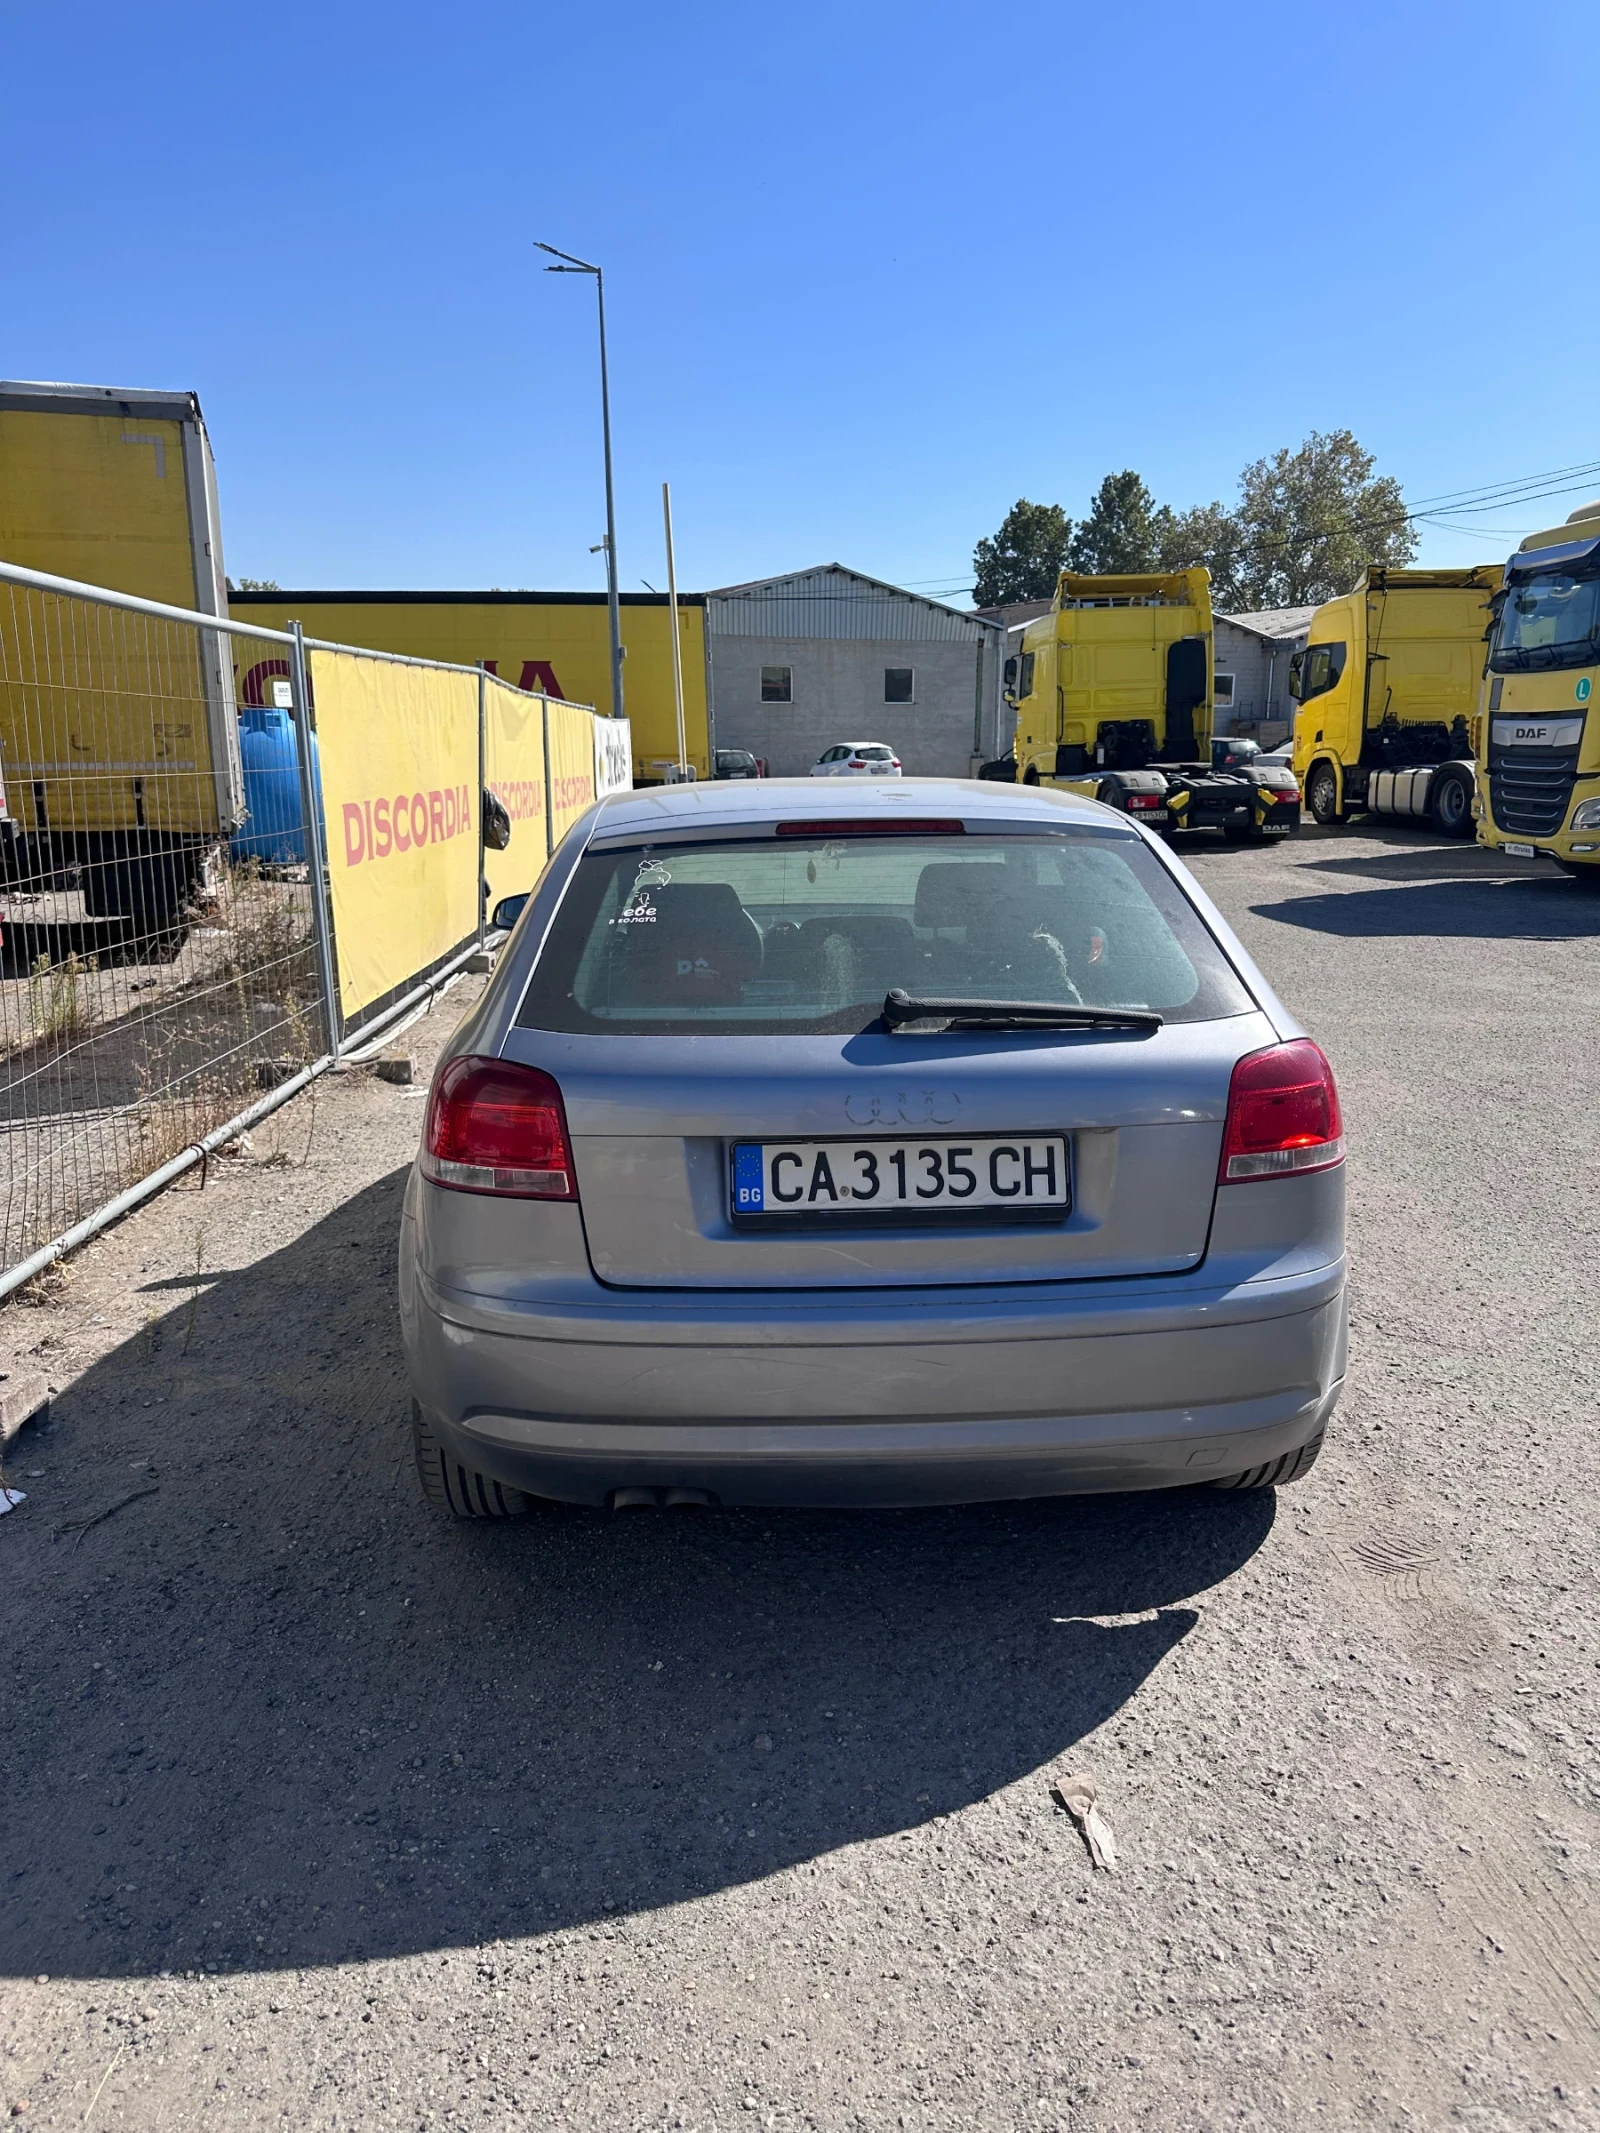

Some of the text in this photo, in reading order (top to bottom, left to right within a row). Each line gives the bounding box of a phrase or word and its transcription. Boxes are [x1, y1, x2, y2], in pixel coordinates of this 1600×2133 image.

[1515, 727, 1547, 739] DAF
[341, 784, 471, 867] DISCORDIA
[771, 1145, 1057, 1202] CA 3135 CH
[739, 1187, 761, 1203] BG
